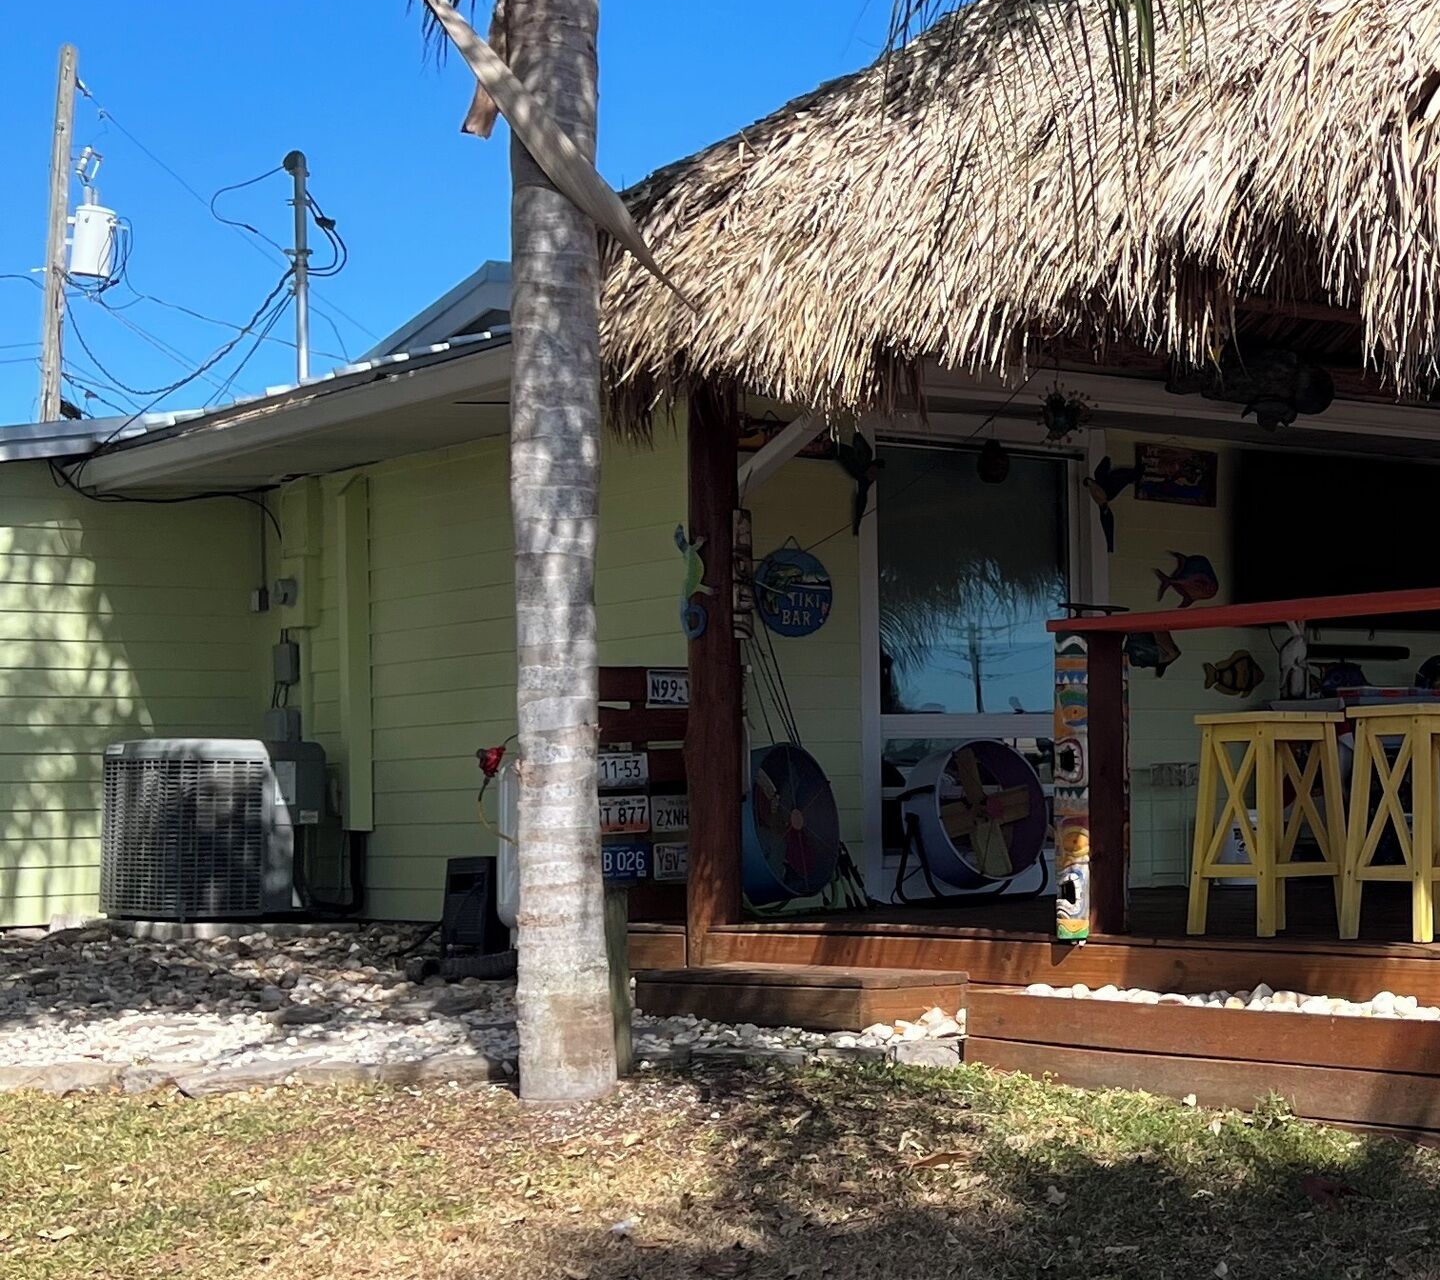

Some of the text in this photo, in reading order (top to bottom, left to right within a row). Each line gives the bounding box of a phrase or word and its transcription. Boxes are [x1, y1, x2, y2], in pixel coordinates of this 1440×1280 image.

[787, 592, 820, 609] TIKI
[782, 609, 811, 626] BAR
[618, 806, 646, 825] 877
[617, 850, 645, 871] 026
